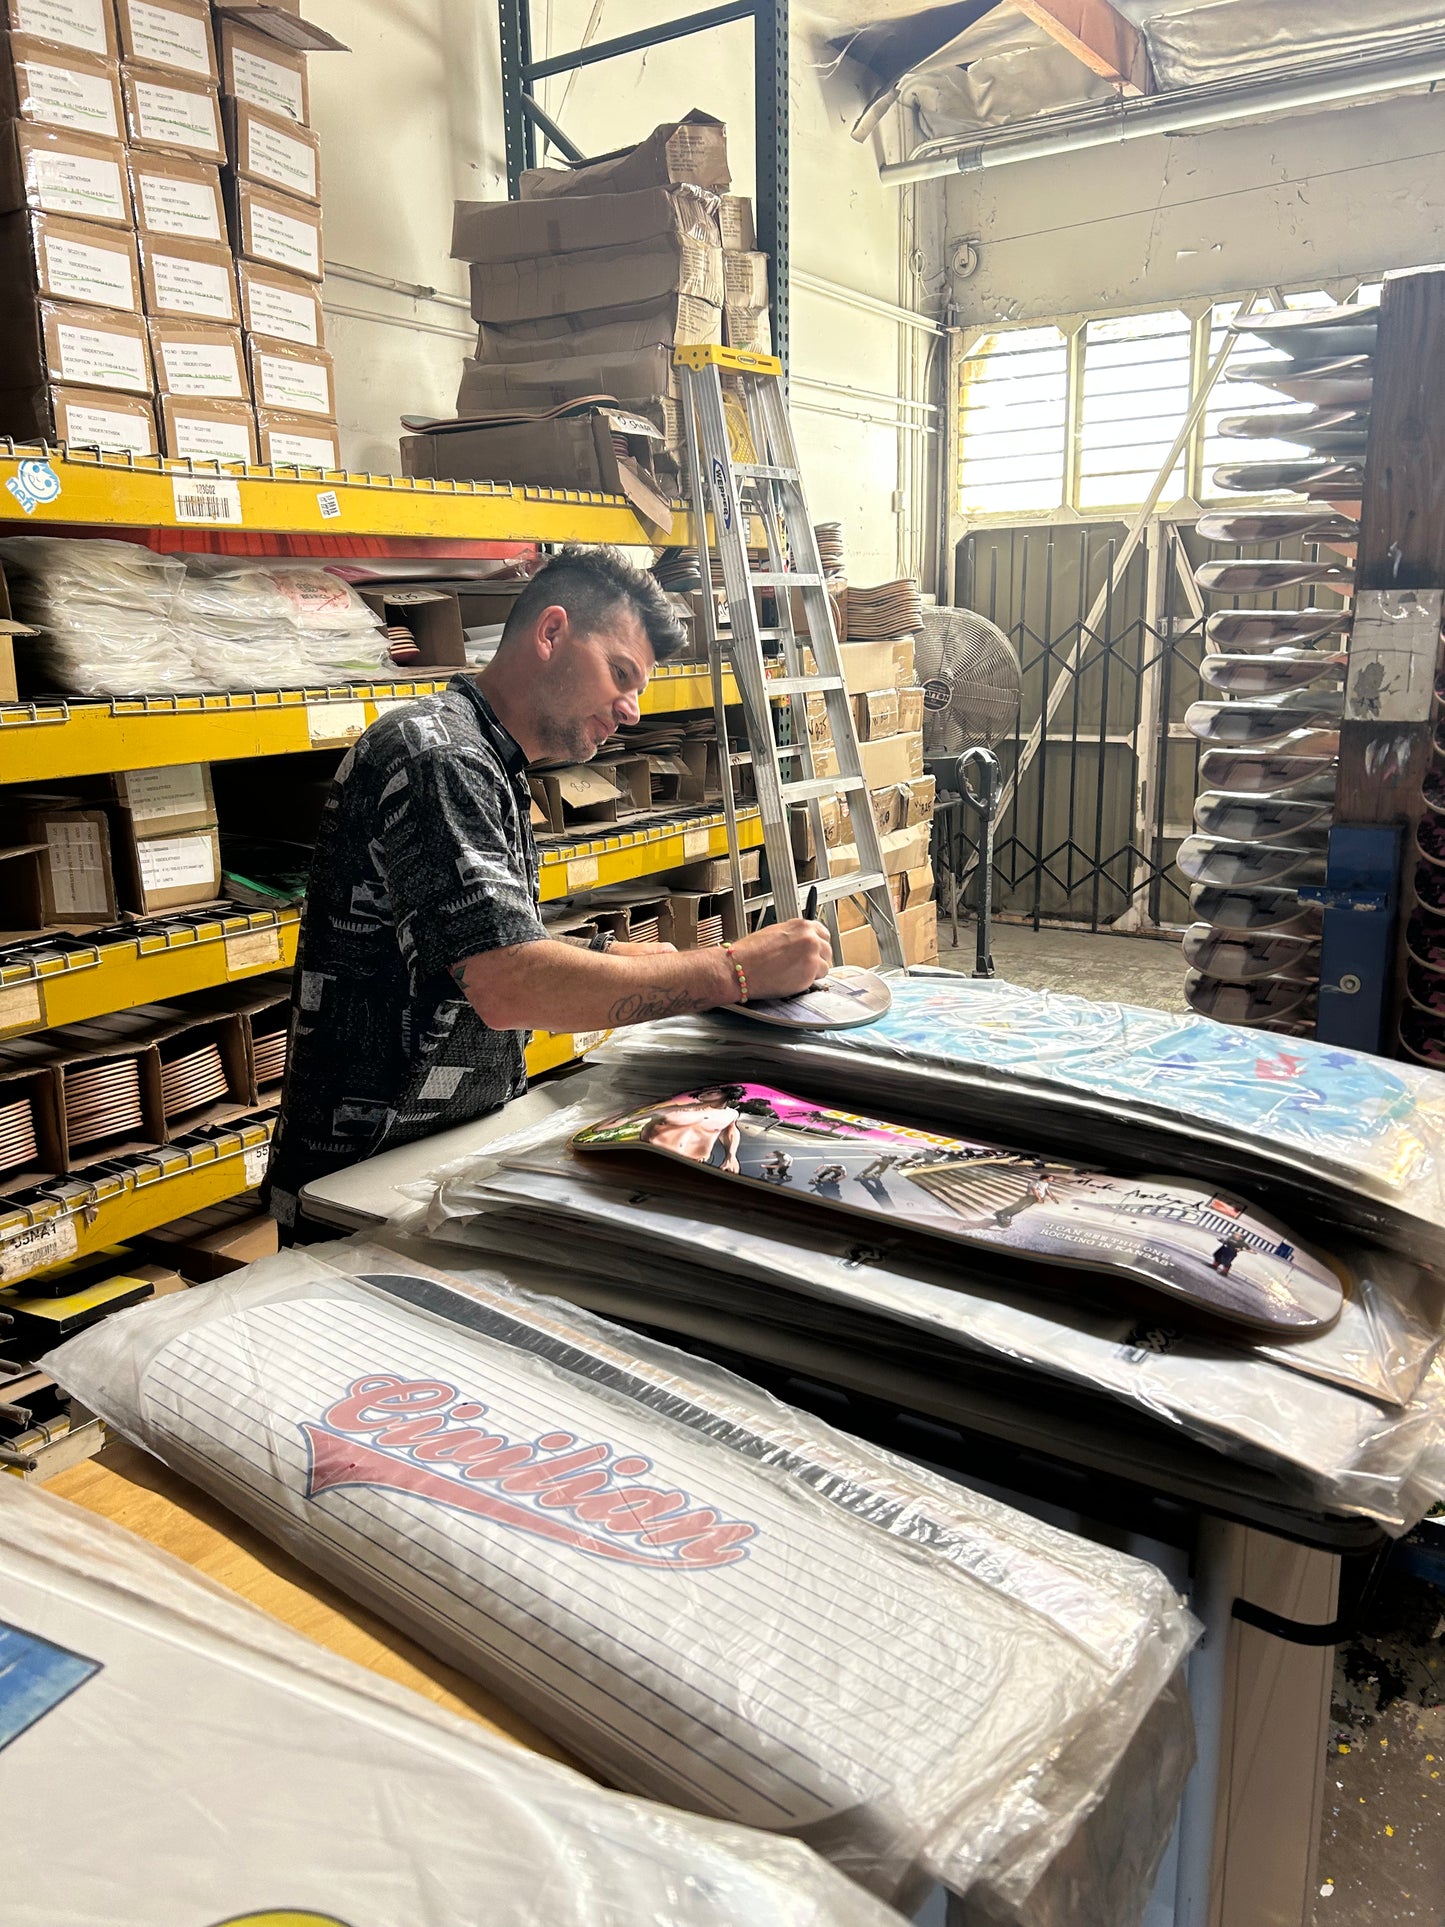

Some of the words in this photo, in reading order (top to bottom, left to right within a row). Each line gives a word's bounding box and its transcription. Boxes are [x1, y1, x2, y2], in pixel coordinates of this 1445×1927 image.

[924, 690, 950, 701] ATTON
[1040, 1228, 1095, 1246] ROCKING
[1098, 1241, 1113, 1250] IN
[1056, 1224, 1082, 1236] CAN
[1084, 1232, 1108, 1242] SEE
[1111, 1238, 1141, 1249] THIS
[1143, 1246, 1171, 1260] ONE
[321, 1373, 759, 1561] Civilian
